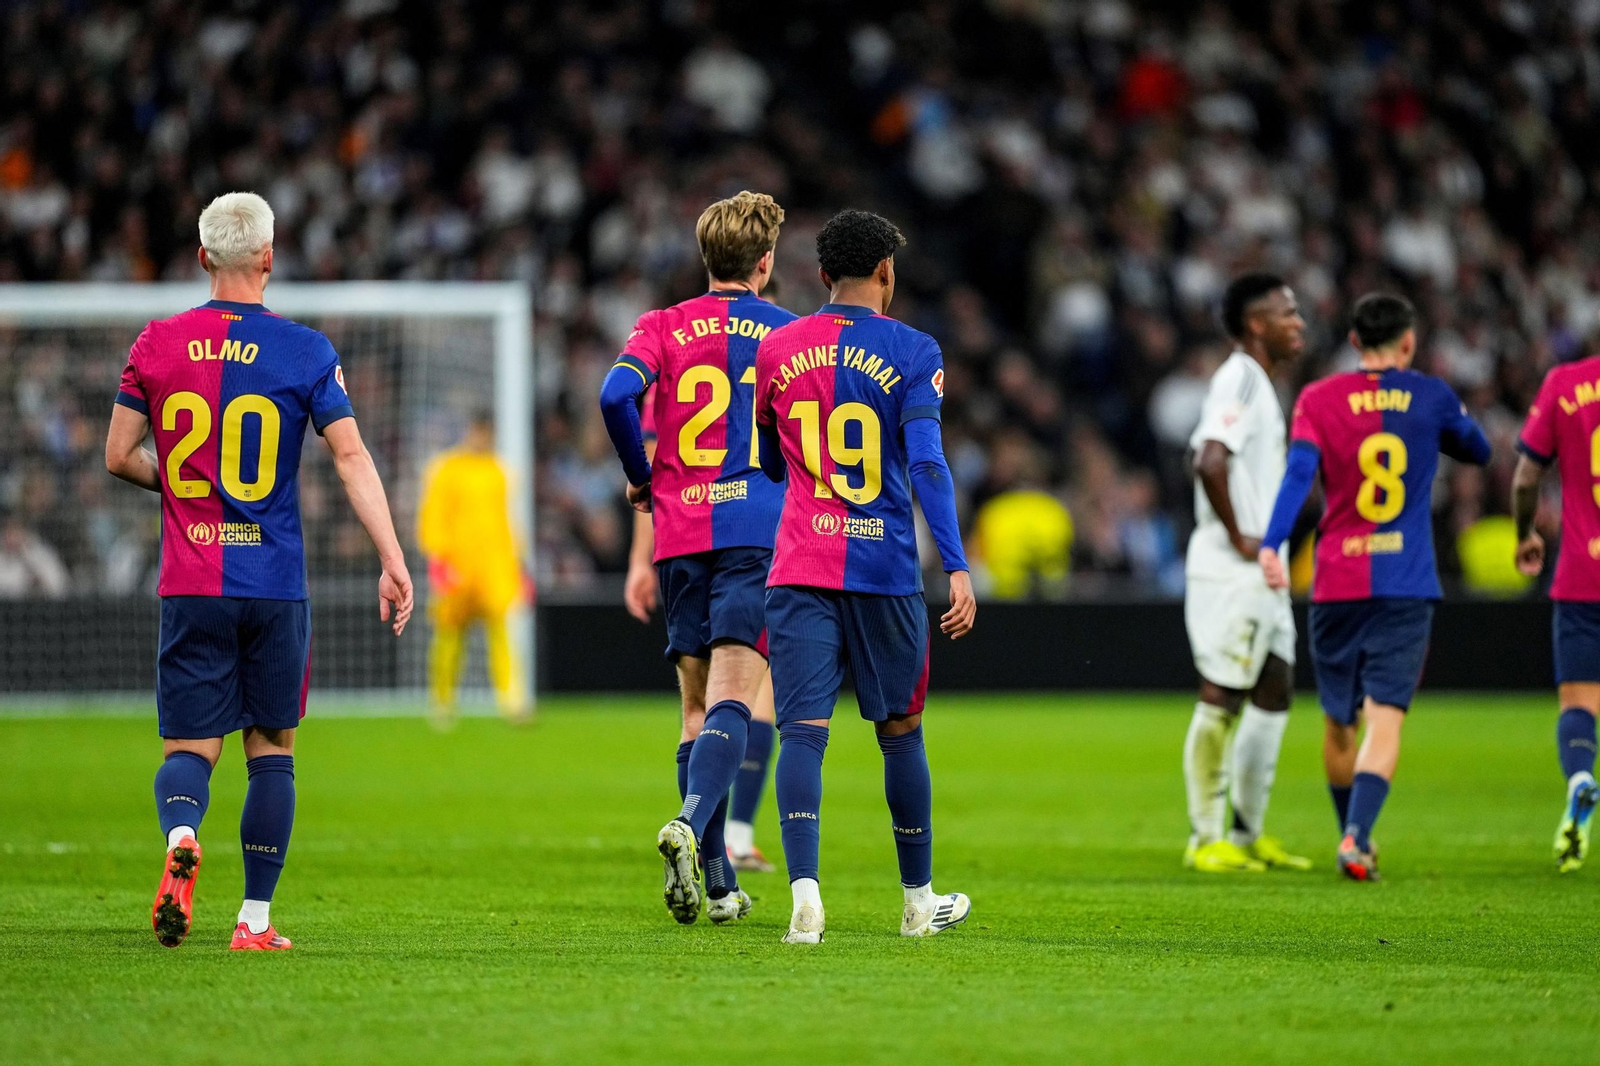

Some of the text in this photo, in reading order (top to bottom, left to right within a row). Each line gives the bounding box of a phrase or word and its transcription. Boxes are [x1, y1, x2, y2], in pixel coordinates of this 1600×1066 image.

[672, 316, 772, 346] F. DE JON
[187, 338, 259, 364] OLMO
[771, 344, 902, 395] LAMINE YAMAL
[162, 391, 281, 502] 20
[788, 400, 882, 505] 19
[708, 480, 748, 493] UNHCR
[1357, 432, 1408, 524] 8
[708, 487, 748, 501] ACNUR
[217, 522, 261, 532] UNHCR
[842, 524, 884, 537] ACNUR
[843, 516, 884, 528] UNHCR
[217, 532, 262, 542] ACNUR
